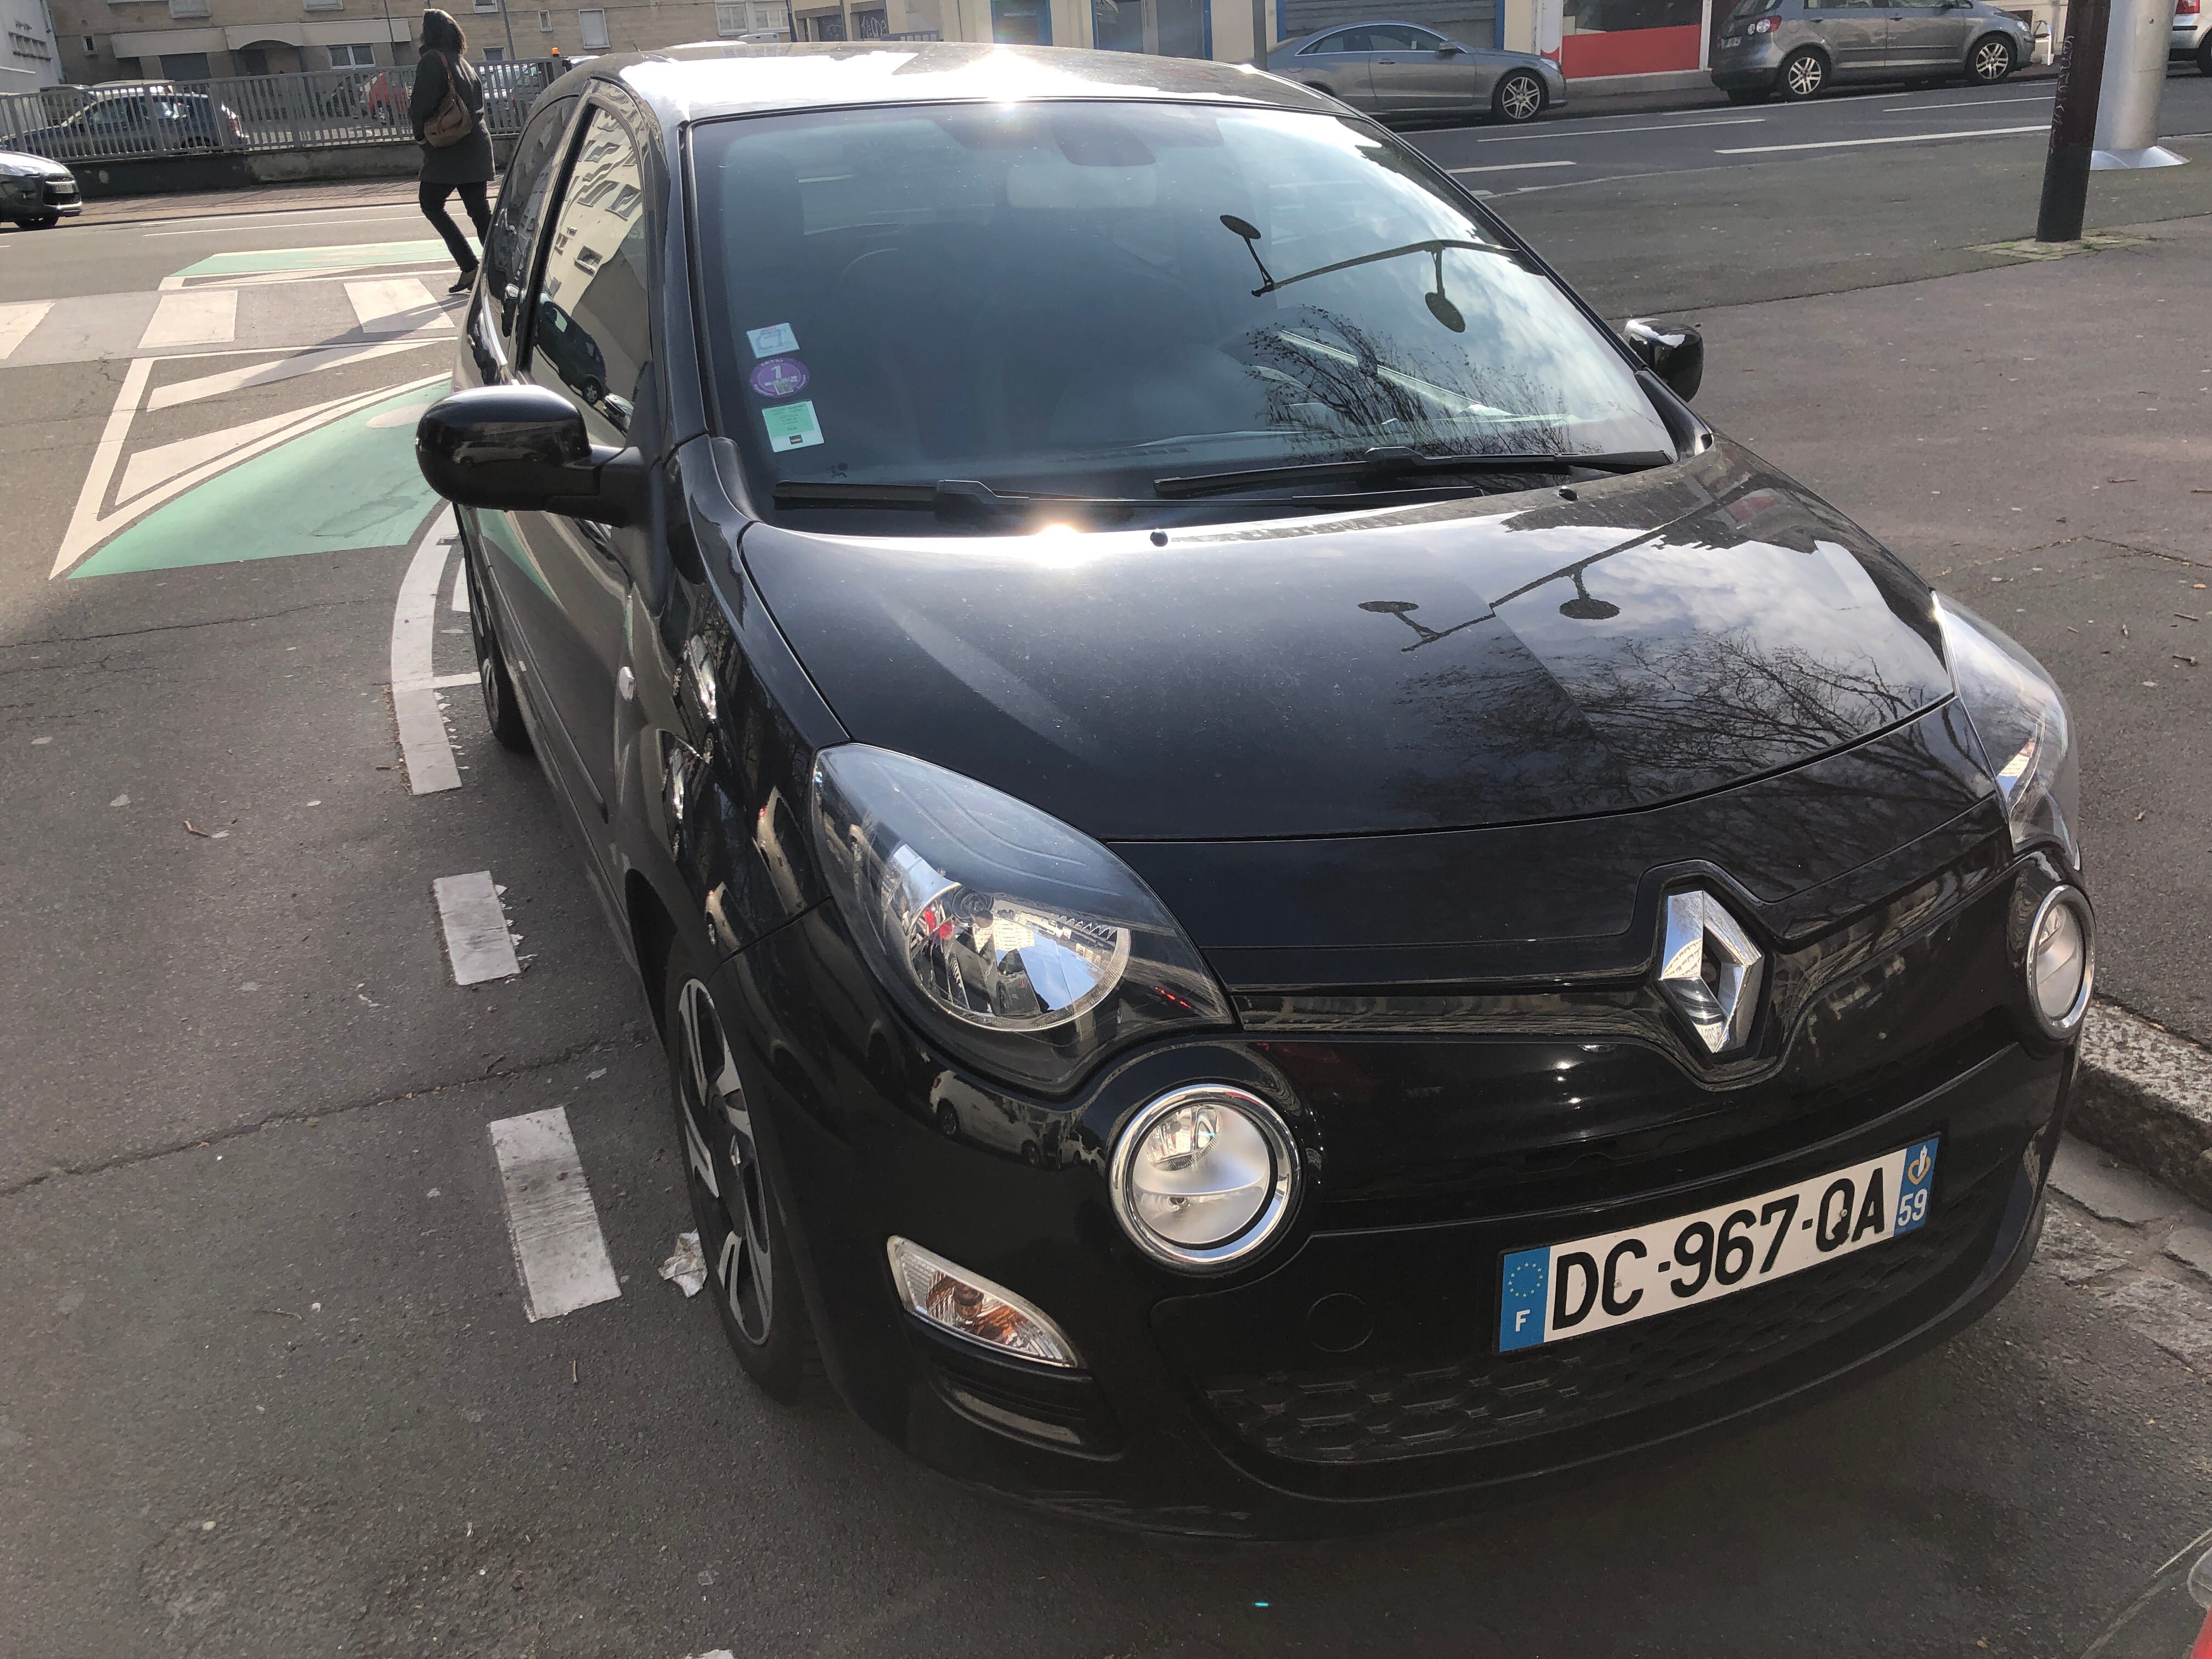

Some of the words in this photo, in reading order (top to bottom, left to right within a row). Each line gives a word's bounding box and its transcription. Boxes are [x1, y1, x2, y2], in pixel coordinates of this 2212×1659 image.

[771, 365, 782, 379] 1
[1897, 1188, 1927, 1227] 59
[1515, 1309, 1531, 1333] F
